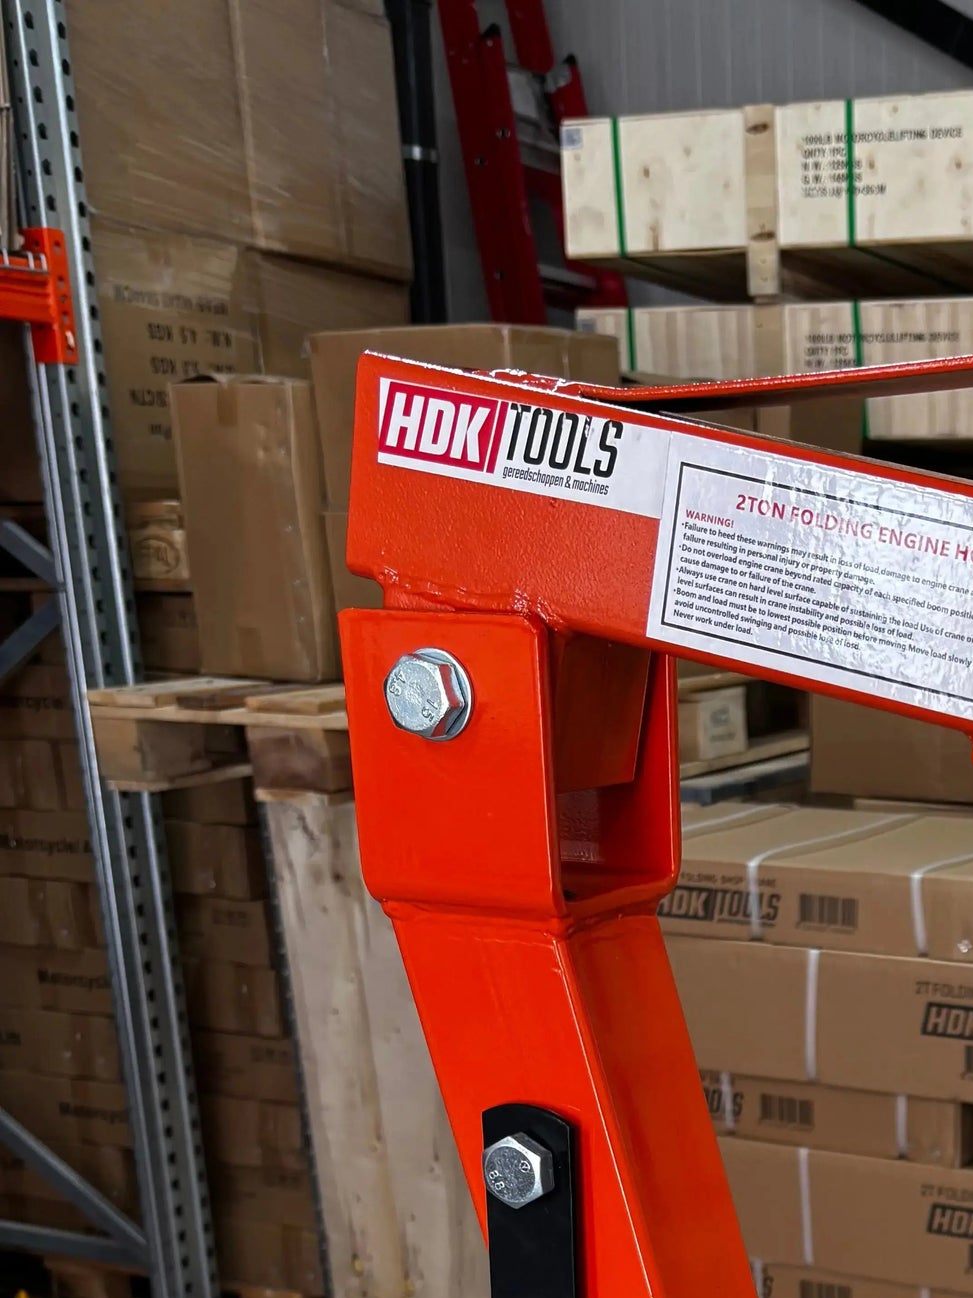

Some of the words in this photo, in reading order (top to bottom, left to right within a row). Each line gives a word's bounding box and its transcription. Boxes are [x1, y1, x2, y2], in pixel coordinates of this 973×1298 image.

[385, 391, 491, 463] HDK
[507, 402, 623, 478] TOOLS
[565, 478, 571, 488] &
[685, 509, 734, 528] WARNING!
[735, 493, 785, 520] 2TON
[789, 505, 873, 540] FOLDING
[878, 525, 950, 557] ENGINE
[682, 532, 705, 544] failure
[706, 539, 737, 554] resulting
[738, 545, 746, 554] in
[746, 549, 778, 561] personal
[778, 555, 799, 569] injury
[801, 561, 809, 569] or
[684, 521, 707, 534] Failure
[709, 527, 716, 536] to
[718, 529, 735, 540] heed
[736, 533, 756, 545] these
[761, 541, 789, 554] warnings
[791, 548, 806, 559] may
[680, 556, 699, 566] cause
[701, 559, 729, 574] damage
[730, 566, 738, 575] to
[748, 570, 771, 583] failure
[772, 577, 780, 585] of
[781, 578, 793, 588] the
[794, 583, 816, 593] crane.
[681, 543, 691, 553] Do
[693, 547, 705, 556] not
[706, 551, 737, 563] overload
[738, 558, 762, 569] engine
[763, 564, 783, 574] crane
[784, 568, 811, 581] beyond
[812, 576, 832, 586] rated
[674, 599, 693, 609] avoid
[694, 604, 739, 620] uncontrolled
[740, 615, 772, 630] swinging
[773, 623, 787, 632] and
[676, 587, 696, 599] Boom
[697, 593, 711, 602] and
[712, 596, 727, 606] load
[728, 601, 746, 611] must
[747, 604, 757, 613] be
[758, 607, 766, 615] to
[767, 609, 790, 621] lowest
[791, 616, 820, 629] possible
[822, 624, 851, 636] position
[677, 576, 694, 587] level
[695, 582, 724, 594] surfaces
[725, 589, 737, 597] can
[738, 592, 759, 602] result
[759, 596, 766, 604] in
[767, 599, 787, 609] crane
[788, 603, 823, 620] instability
[824, 613, 838, 622] and
[678, 565, 703, 579] Always
[704, 573, 716, 581] use
[717, 576, 737, 586] crane
[738, 581, 747, 589] on
[749, 582, 765, 593] hard
[766, 586, 783, 597] level
[784, 592, 810, 604] surface
[811, 599, 839, 611] capable
[840, 605, 849, 613] of
[944, 630, 965, 641] crane
[673, 608, 694, 620] Never
[695, 615, 712, 625] work
[713, 620, 734, 630] under
[735, 624, 752, 635] load.
